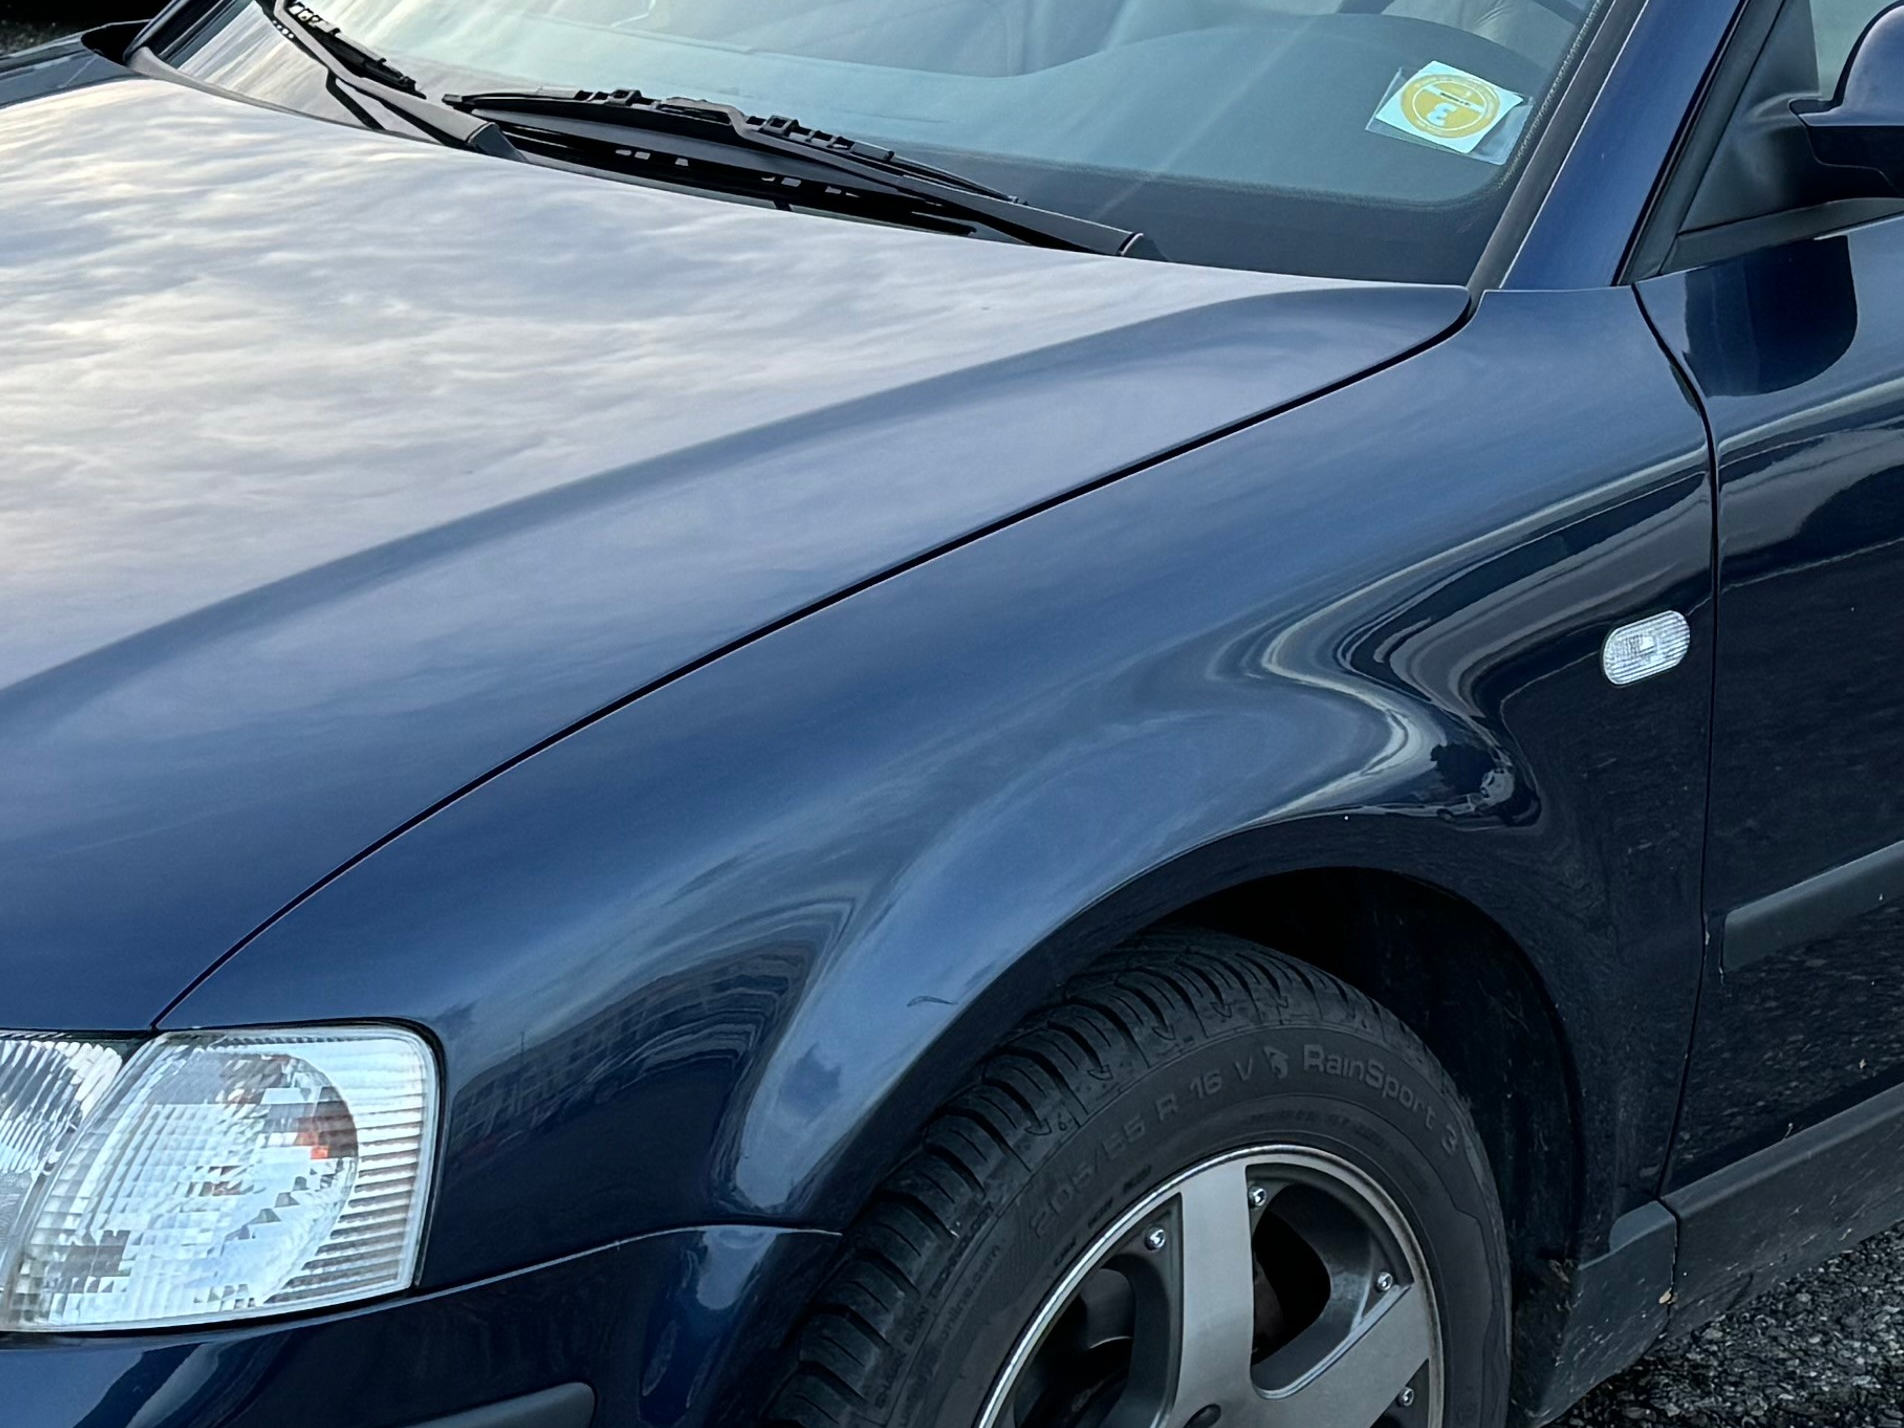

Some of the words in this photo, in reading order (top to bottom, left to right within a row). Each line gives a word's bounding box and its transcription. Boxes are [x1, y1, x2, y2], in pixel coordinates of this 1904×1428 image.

[1190, 1068, 1224, 1100] 16
[1303, 1043, 1437, 1131] RainSport
[1440, 1124, 1458, 1156] 3
